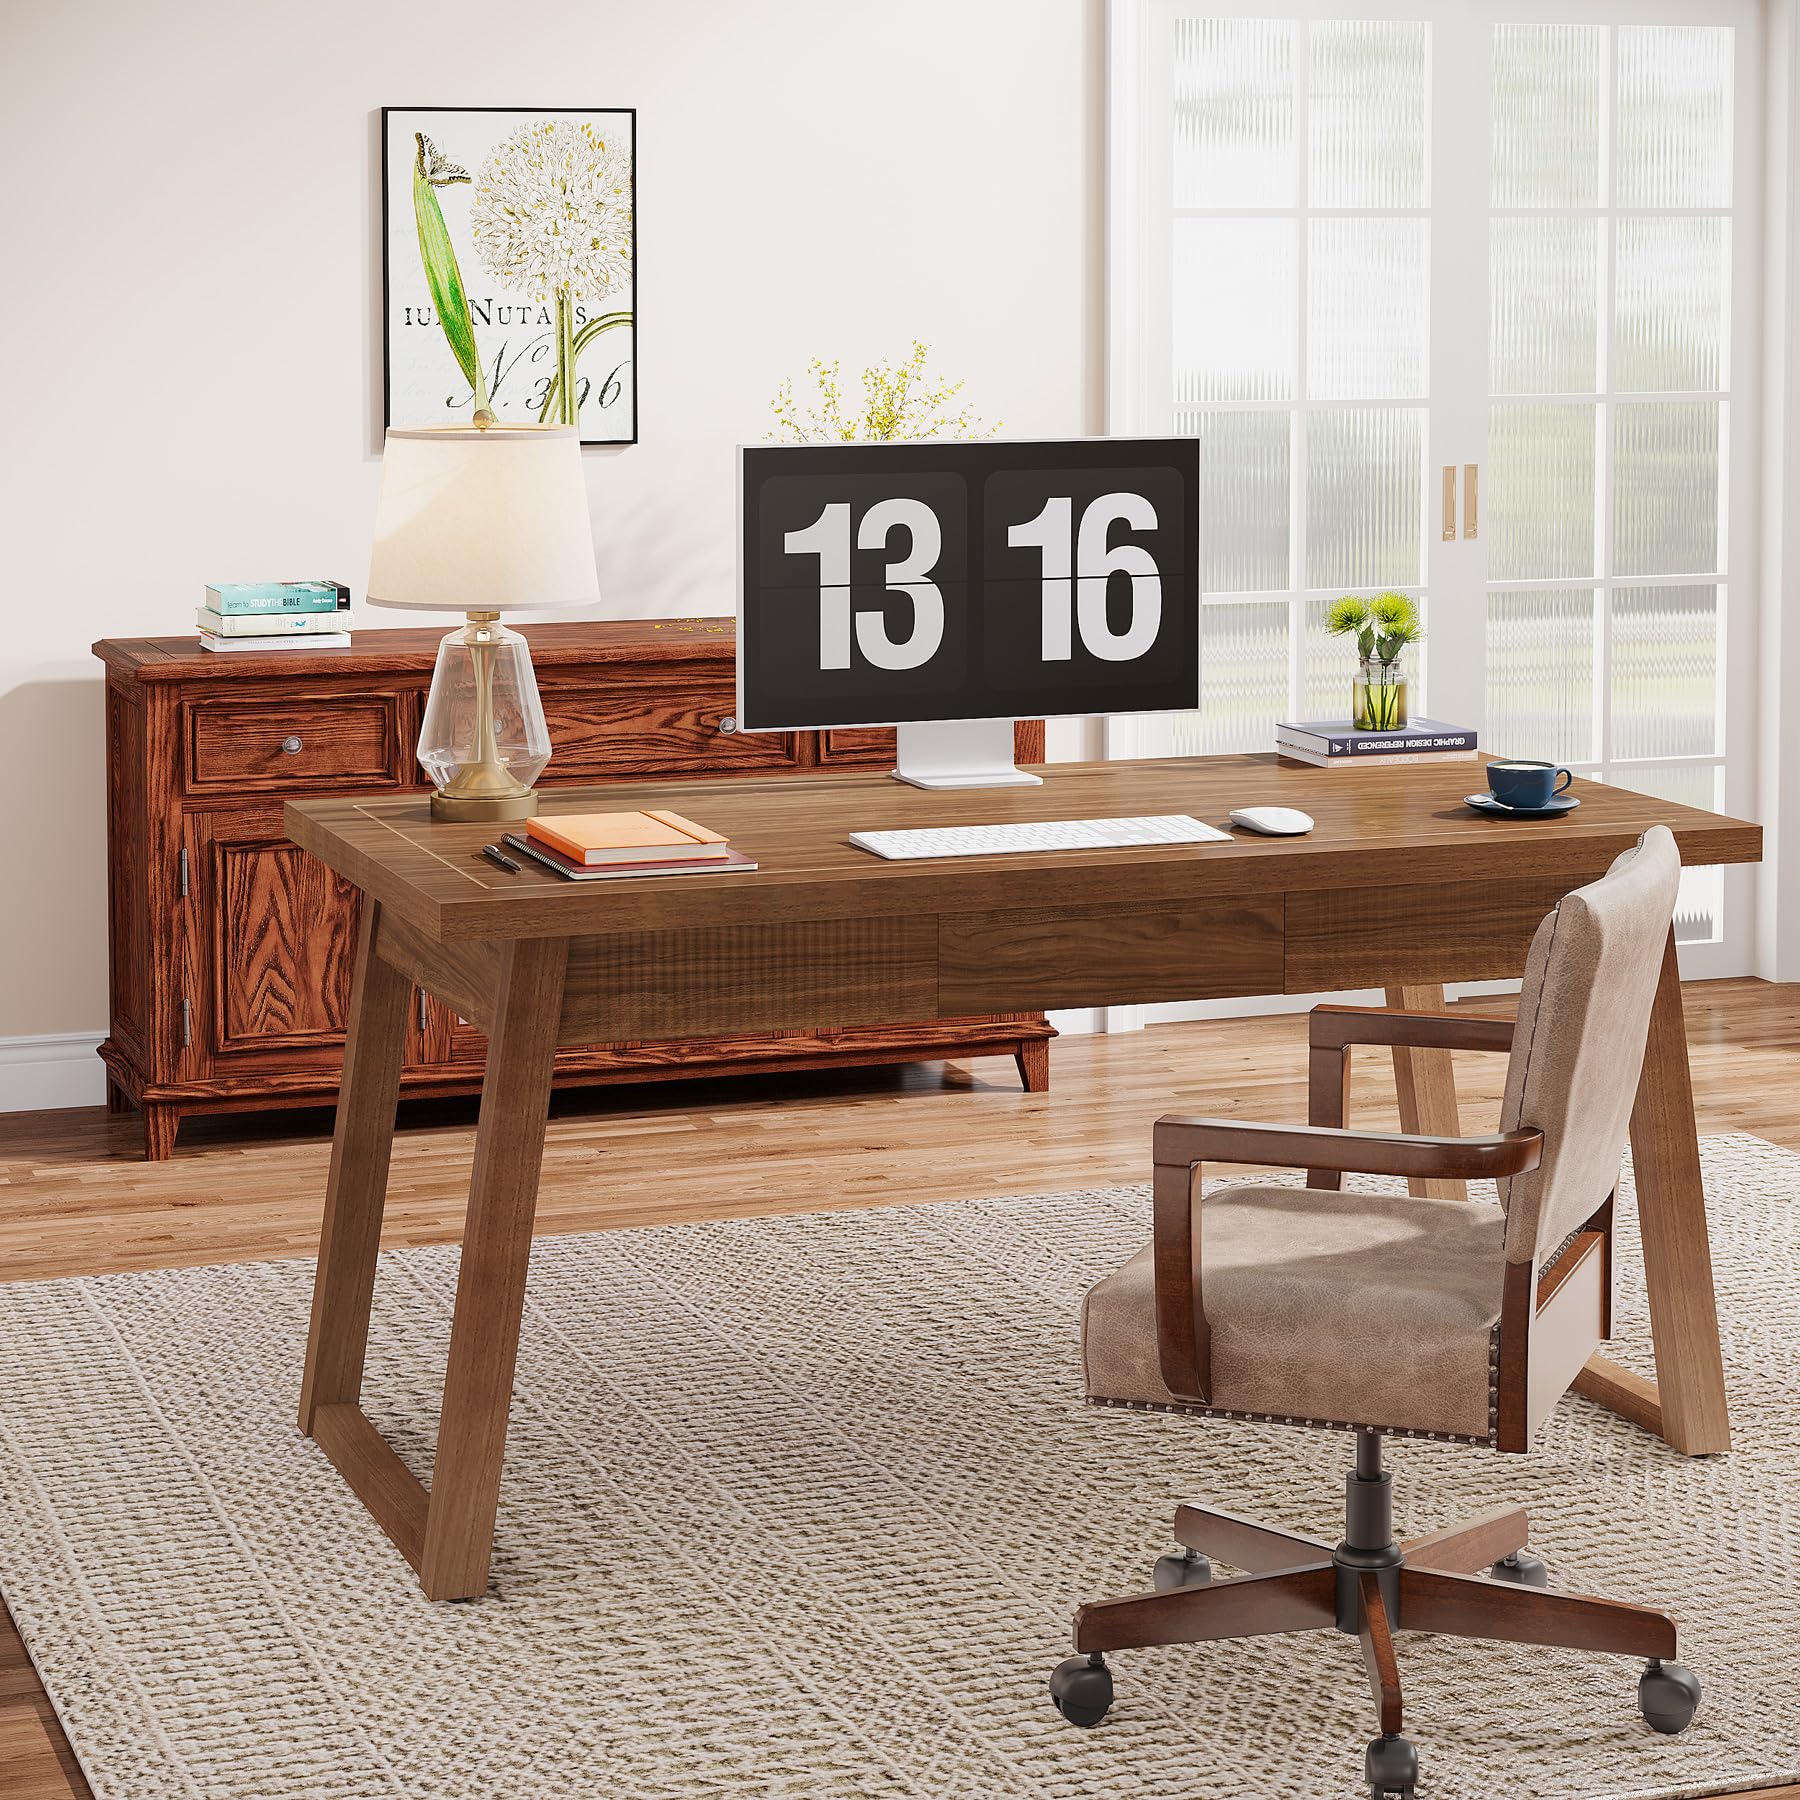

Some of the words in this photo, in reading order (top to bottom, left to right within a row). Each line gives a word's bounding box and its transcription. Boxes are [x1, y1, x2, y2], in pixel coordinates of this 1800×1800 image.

[404, 307, 441, 326] IU
[784, 498, 945, 670] 13
[1007, 492, 1162, 661] 16
[1357, 740, 1405, 750] REFERENCED
[1406, 738, 1433, 748] DESIGN
[1433, 737, 1466, 747] GRAPHIC
